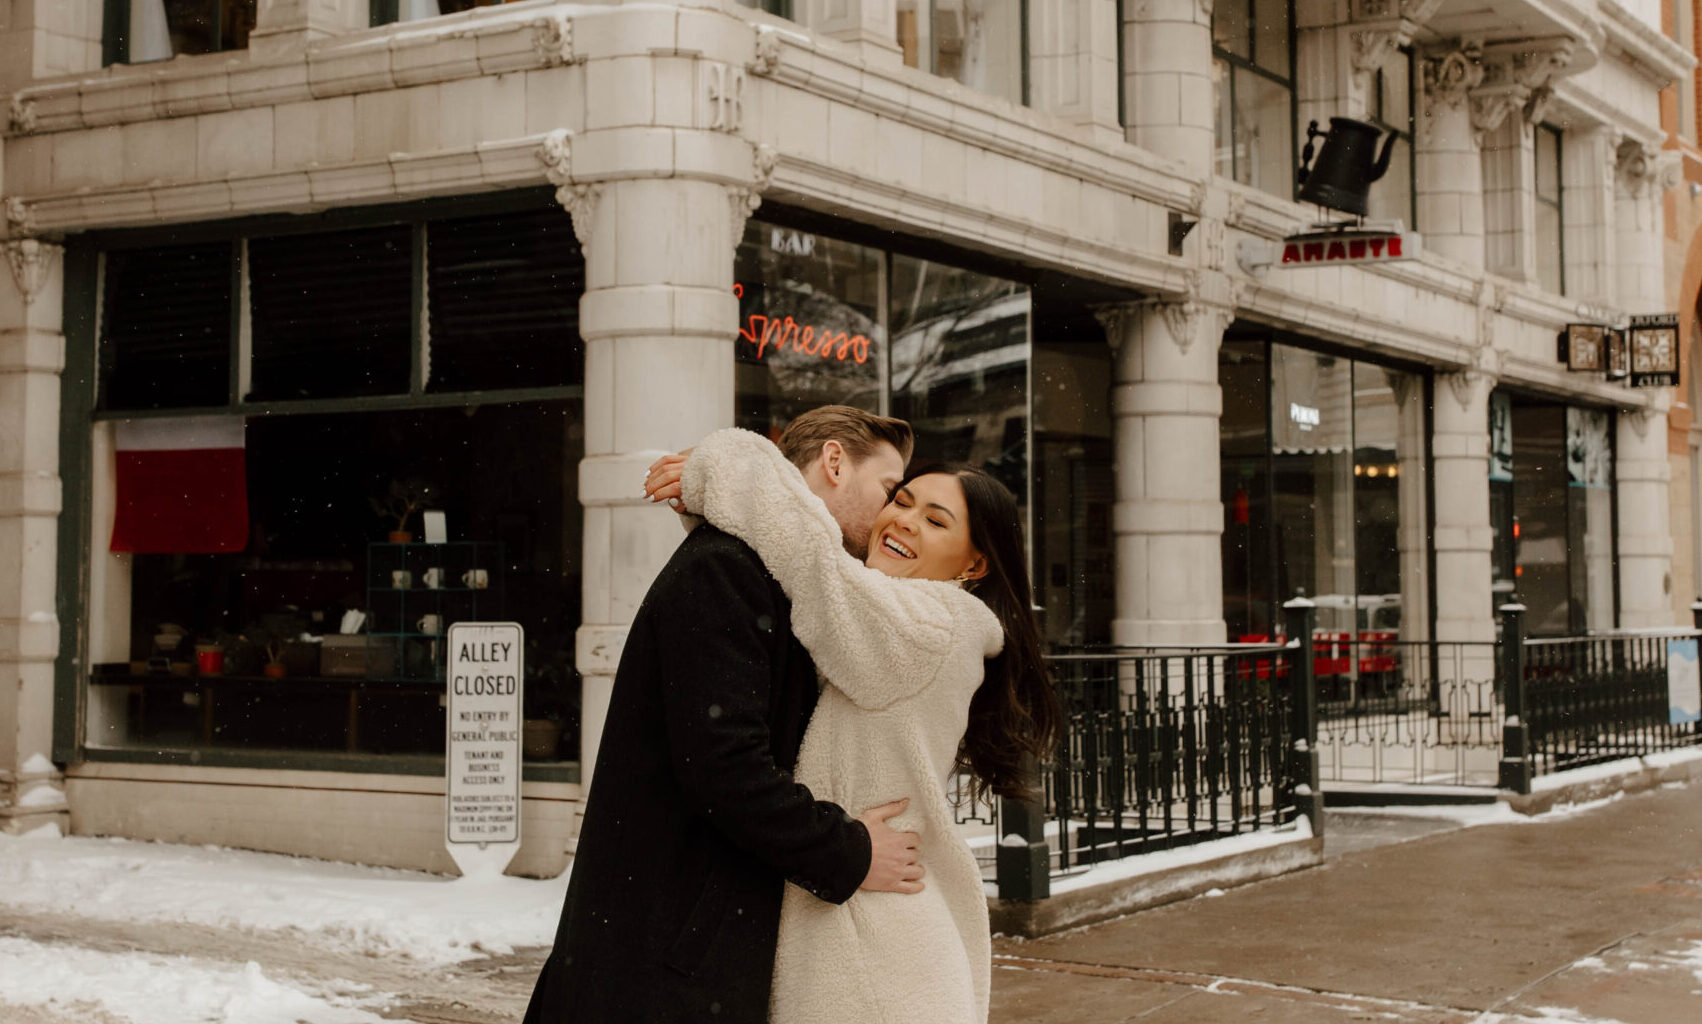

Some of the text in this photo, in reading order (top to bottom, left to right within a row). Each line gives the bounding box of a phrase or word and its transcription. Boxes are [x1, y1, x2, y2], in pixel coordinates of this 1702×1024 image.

[771, 228, 816, 257] BAR
[459, 642, 511, 662] ALLEY
[454, 675, 516, 696] CLOSED
[459, 711, 509, 721] NO ENTRY BY
[451, 731, 517, 742] GENERAL PUBLIC
[490, 750, 504, 759] AND
[488, 776, 505, 784] ONLY
